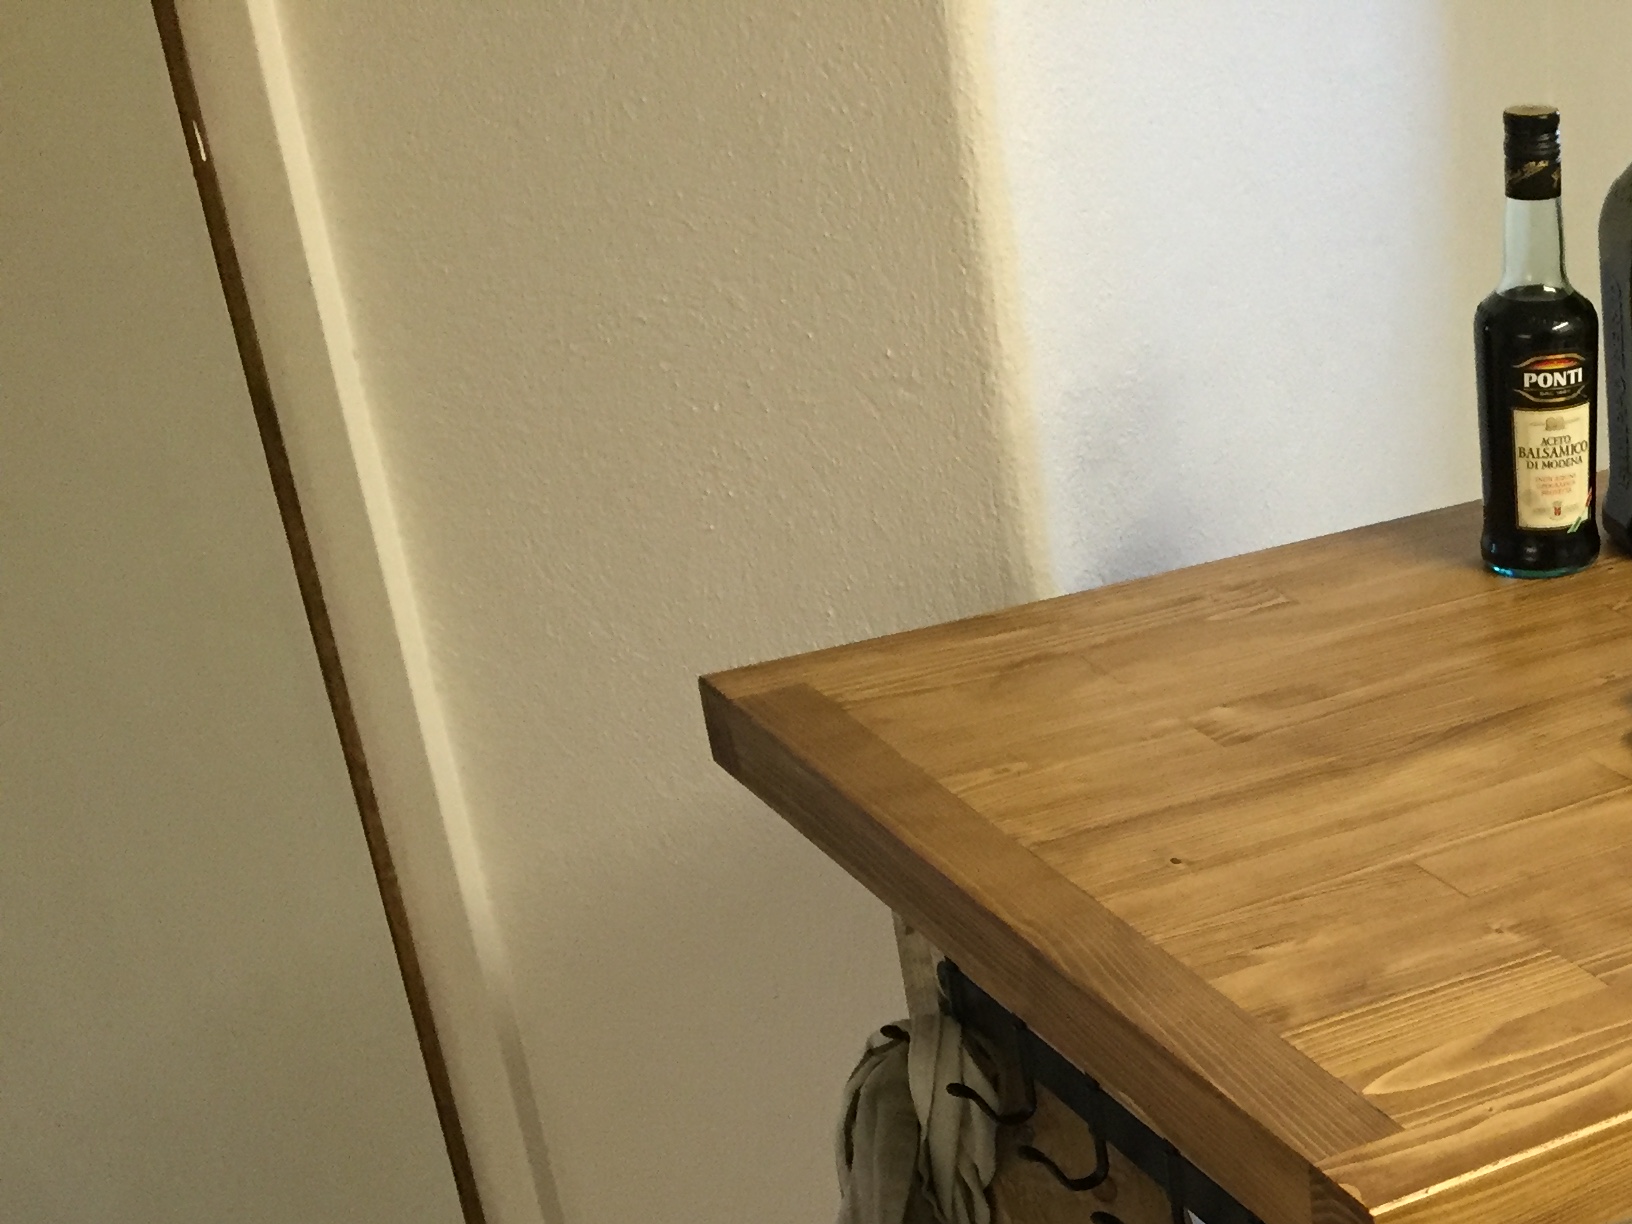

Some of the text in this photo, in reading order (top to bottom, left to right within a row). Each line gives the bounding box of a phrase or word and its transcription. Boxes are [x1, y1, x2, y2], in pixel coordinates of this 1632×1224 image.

[1523, 367, 1583, 388] PONTI
[1518, 440, 1588, 459] BALSAMICO
[1541, 435, 1572, 447] ACETO
[1526, 455, 1583, 470] DI MODENA
